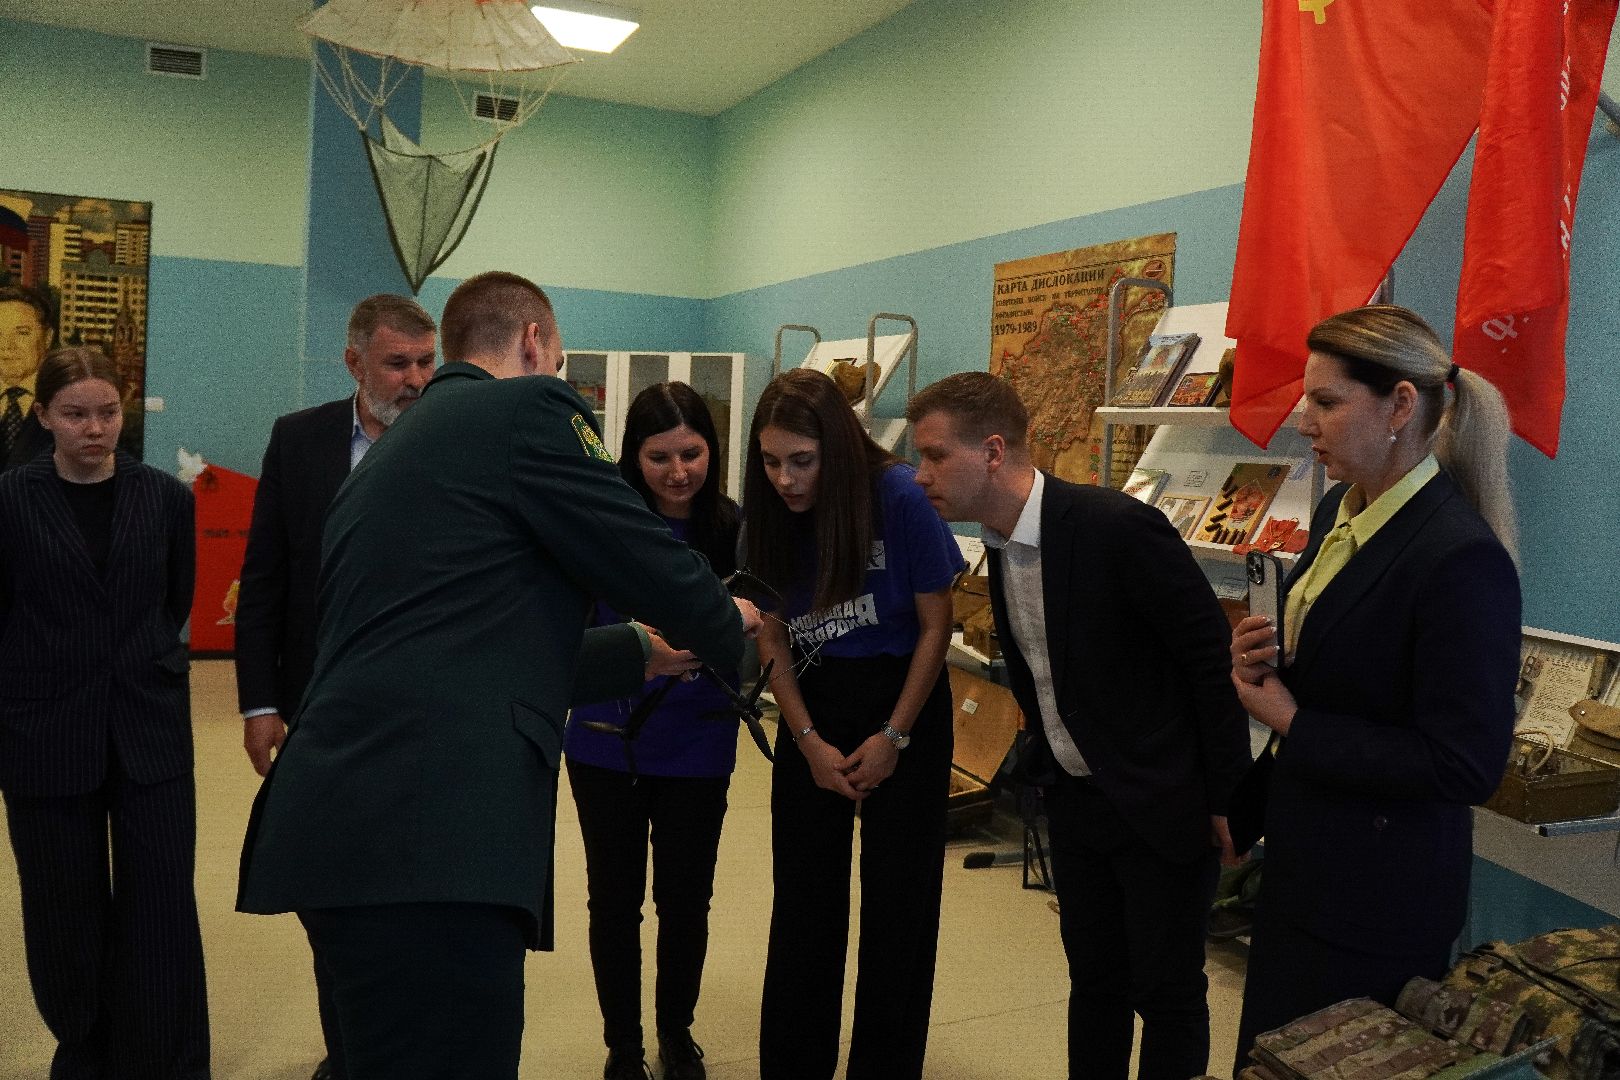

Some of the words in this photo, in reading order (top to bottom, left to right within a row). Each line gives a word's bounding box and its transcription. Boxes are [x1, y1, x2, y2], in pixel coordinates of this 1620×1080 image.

[997, 281, 1028, 295] КАРТА
[1031, 268, 1105, 291] ДИСЛОКАЦИИ
[1028, 295, 1047, 303] ВОЙСК
[994, 321, 1038, 336] 1979-1989
